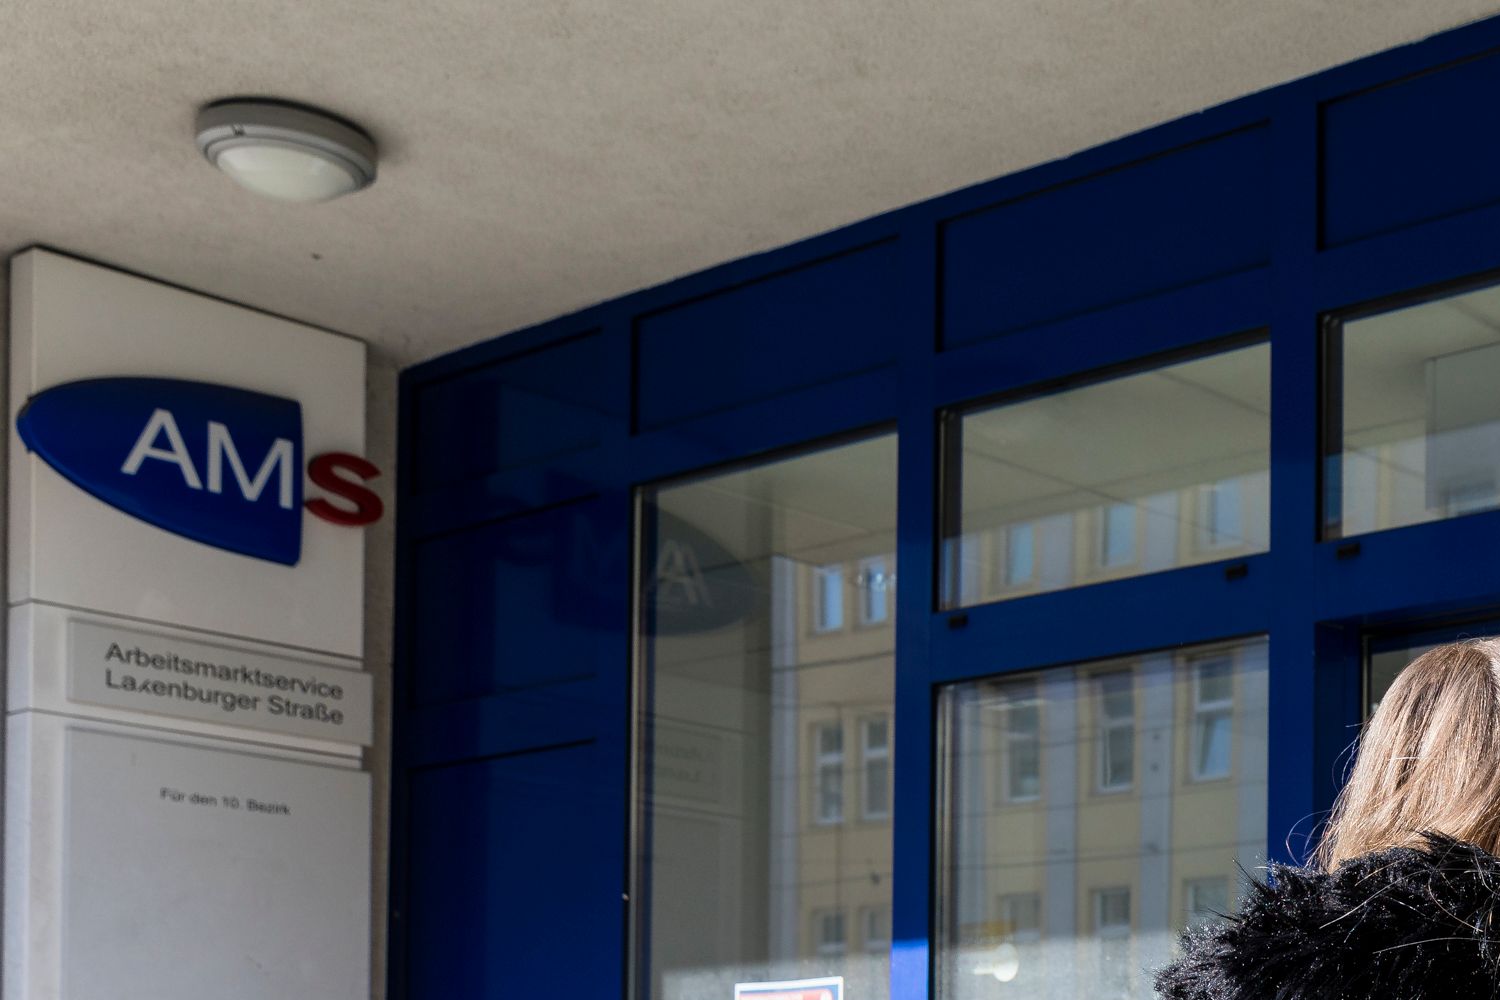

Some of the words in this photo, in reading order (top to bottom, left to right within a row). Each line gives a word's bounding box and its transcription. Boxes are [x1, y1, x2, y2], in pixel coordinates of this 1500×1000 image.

[121, 408, 384, 527] AMS
[105, 641, 344, 700] Arbeitsmarktservice
[105, 668, 259, 712] Laxenburger
[268, 695, 344, 726] Straße
